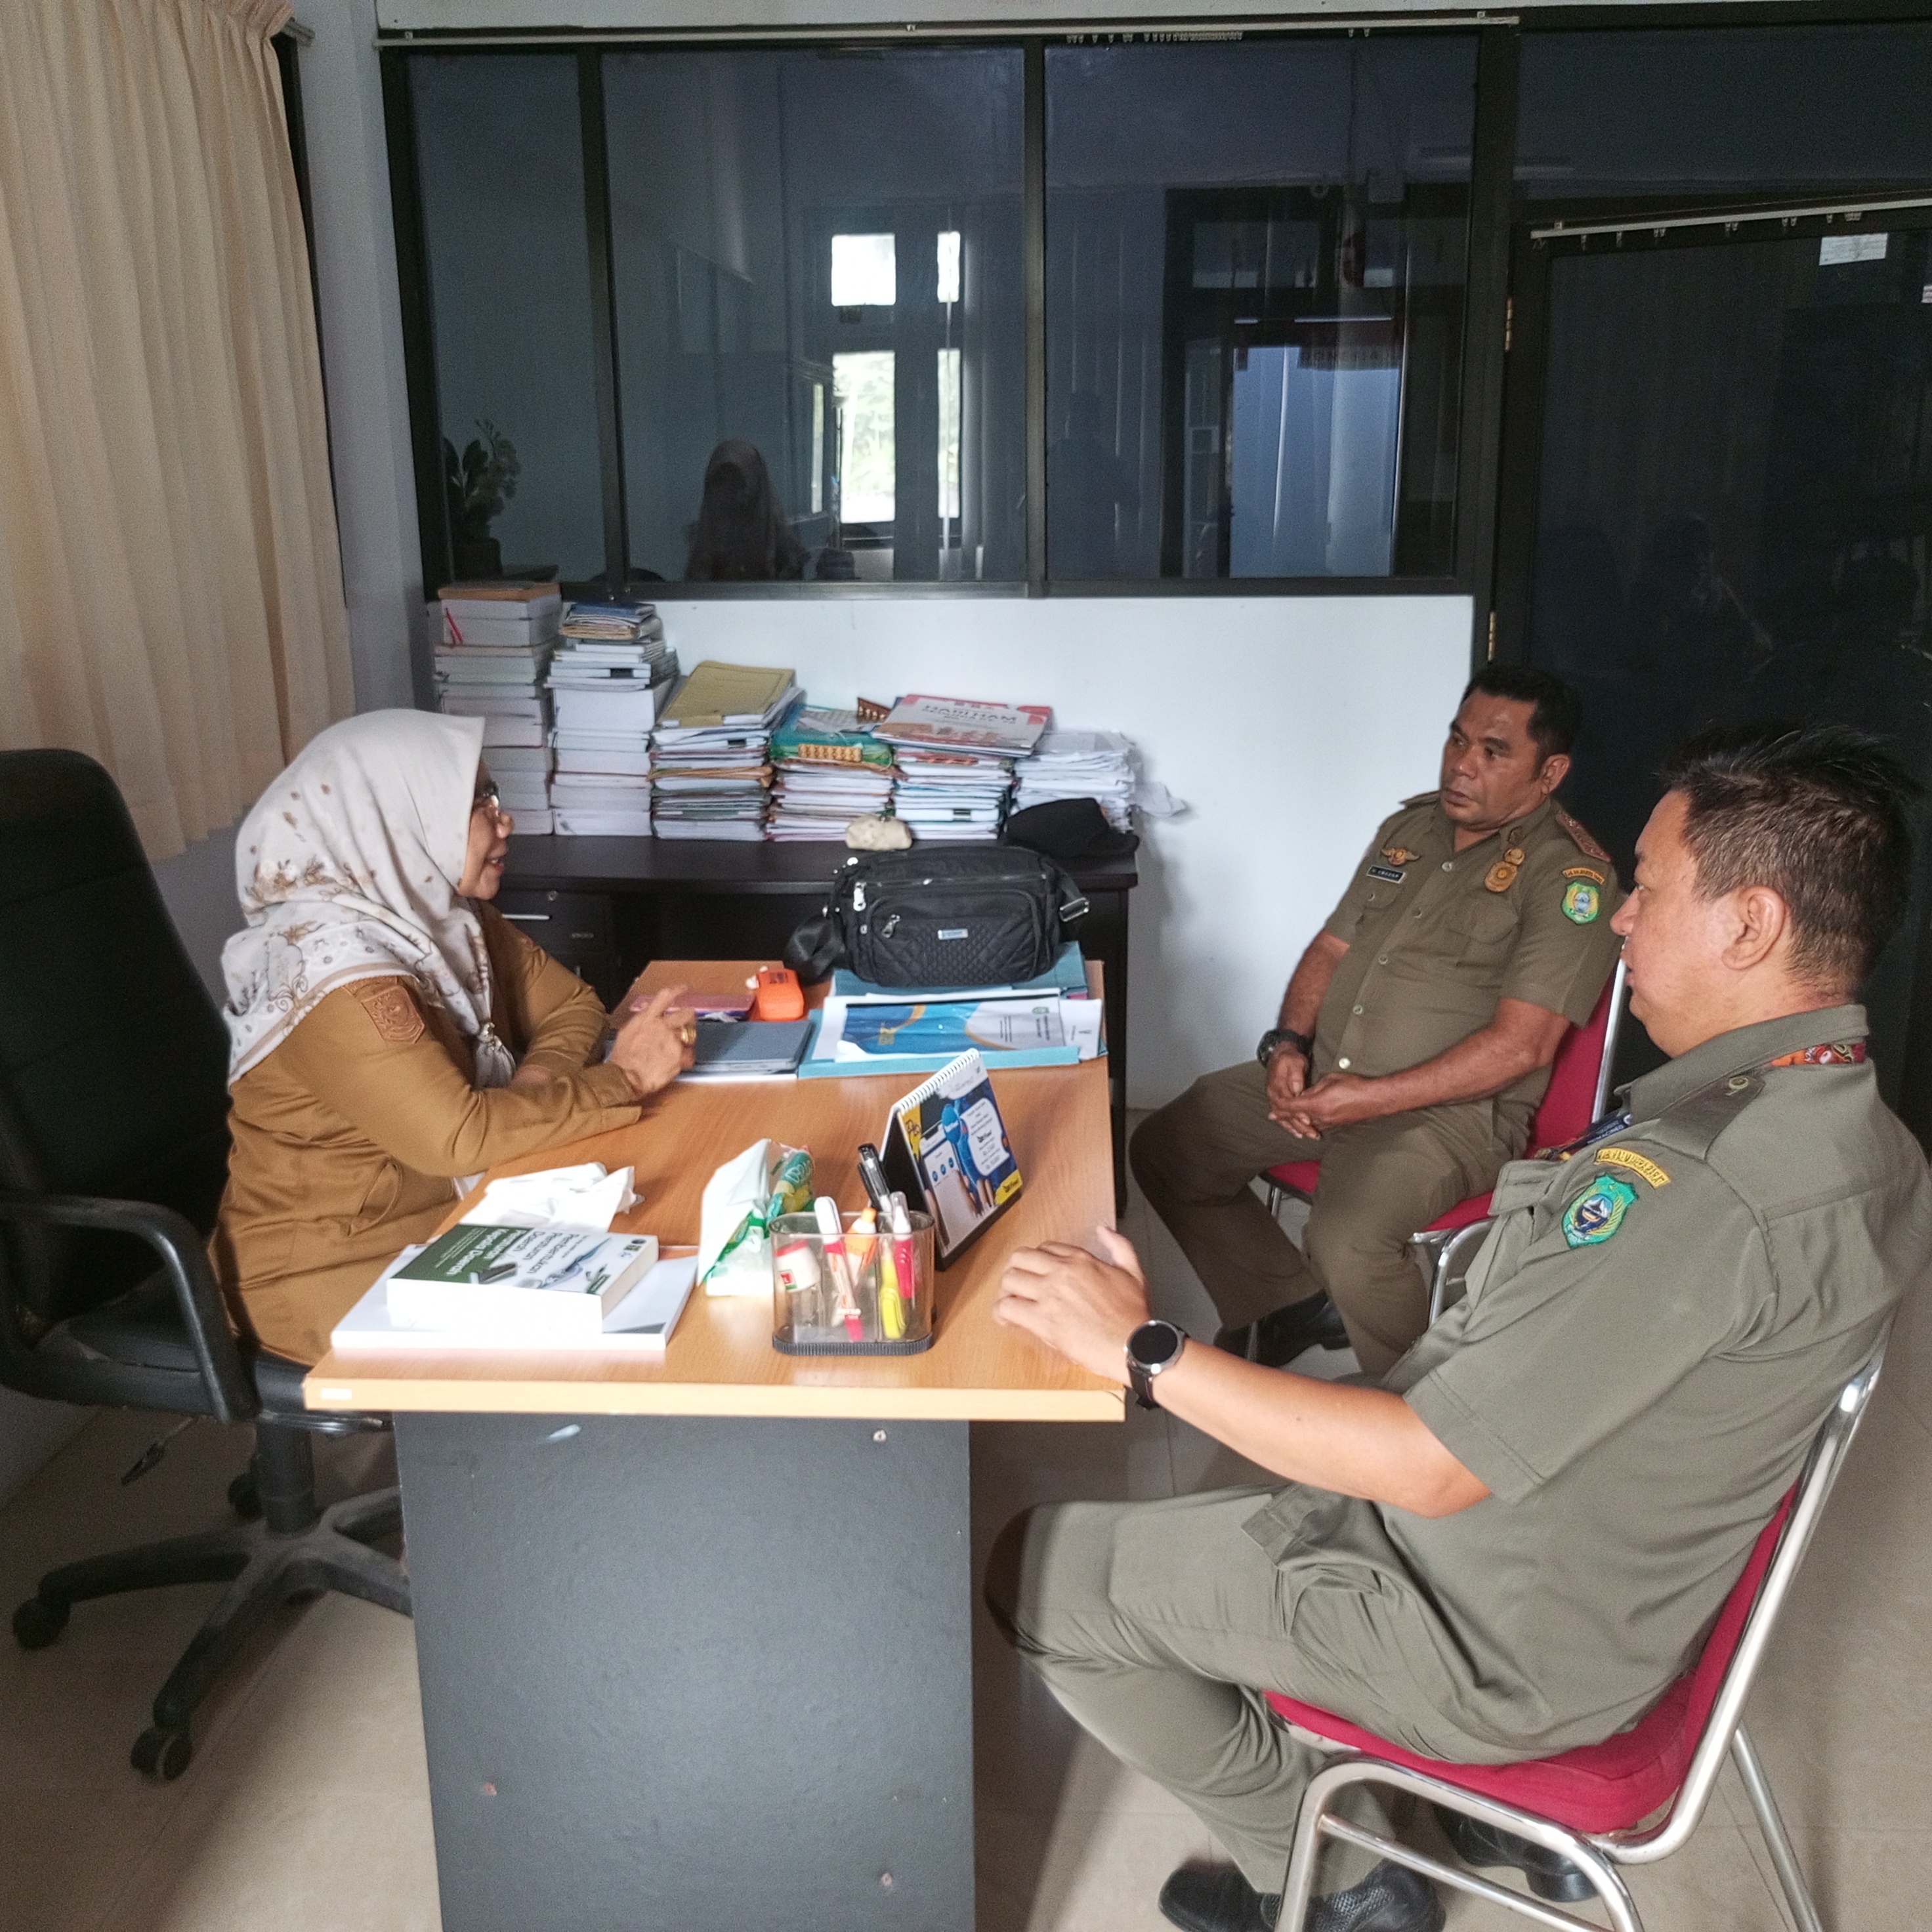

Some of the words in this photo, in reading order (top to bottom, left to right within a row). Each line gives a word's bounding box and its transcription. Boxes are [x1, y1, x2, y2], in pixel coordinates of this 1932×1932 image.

[471, 1228, 510, 1251] Kepala
[483, 1229, 525, 1259] Peraturan
[513, 1231, 546, 1252] Daerah
[523, 1232, 563, 1260] Peraturan
[446, 1250, 483, 1276] Daerah
[527, 1234, 579, 1274] Pembentukan
